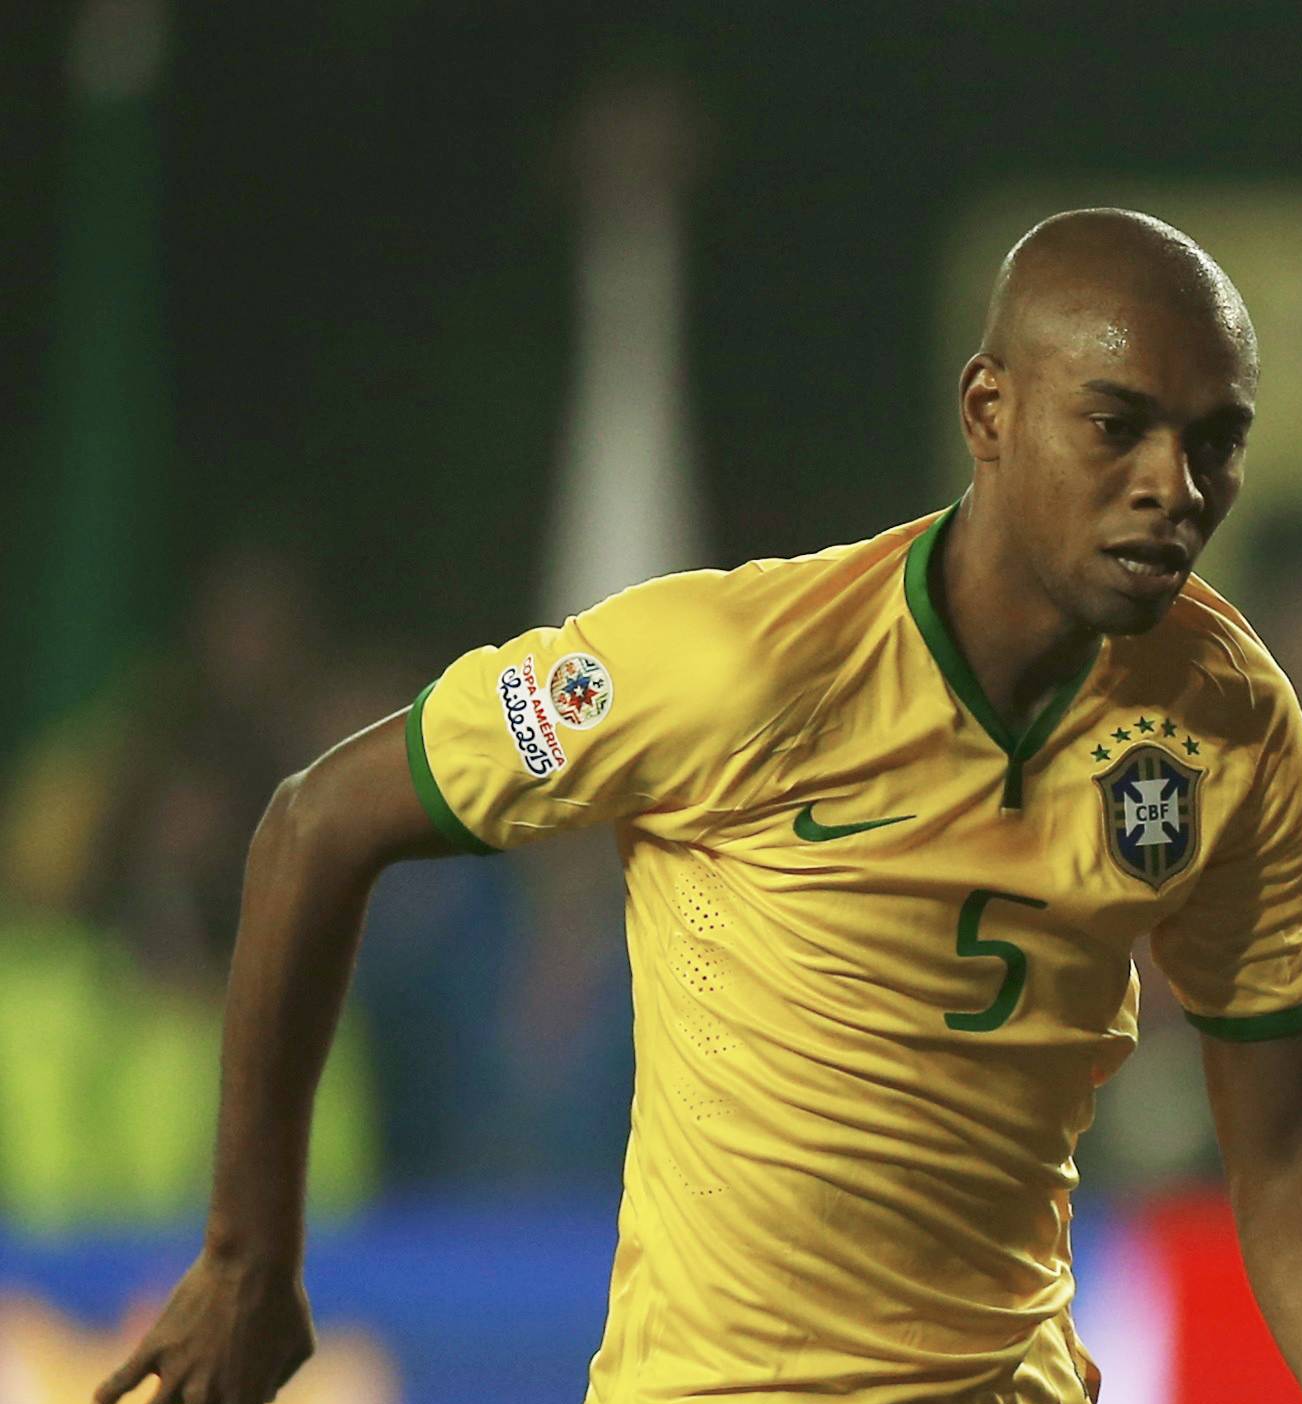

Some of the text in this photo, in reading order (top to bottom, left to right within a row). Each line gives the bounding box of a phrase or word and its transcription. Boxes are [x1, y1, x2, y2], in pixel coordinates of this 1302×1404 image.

[500, 668, 553, 775] Chile 2015
[1135, 803, 1169, 822] CBF
[944, 888, 1047, 1032] 5
